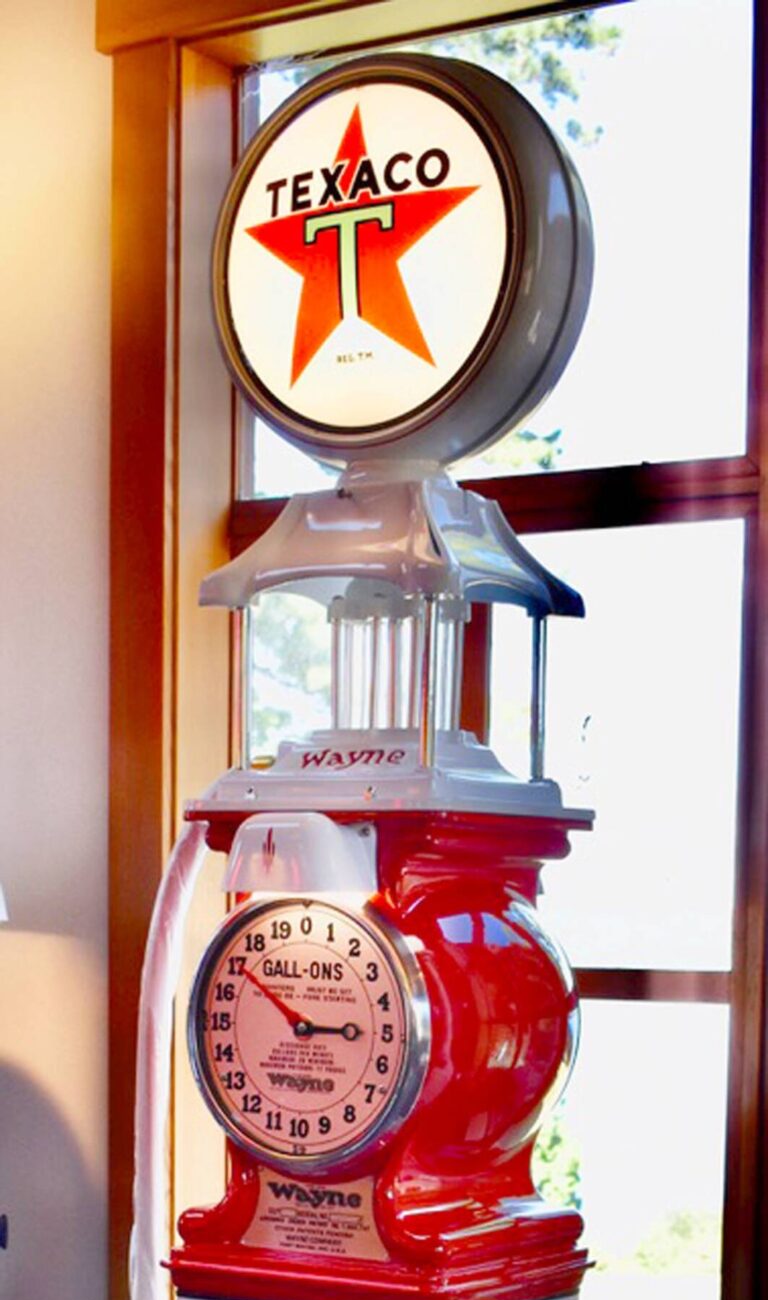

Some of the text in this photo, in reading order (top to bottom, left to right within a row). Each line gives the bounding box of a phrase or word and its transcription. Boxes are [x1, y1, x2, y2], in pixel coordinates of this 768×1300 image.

[266, 148, 450, 218] TEXACO
[303, 200, 394, 320] T
[301, 748, 406, 771] Wayne
[271, 921, 292, 939] 19
[301, 917, 312, 935] 0
[327, 923, 335, 942] 1
[245, 934, 266, 952] 18
[349, 938, 361, 957] 2
[228, 957, 247, 976] 17
[263, 959, 344, 982] GALL-ONS
[366, 963, 378, 982] 3
[216, 984, 235, 1001] 16
[377, 993, 390, 1011] 4
[211, 1012, 231, 1031] 15
[381, 1024, 393, 1043] 5
[215, 1043, 234, 1062] 14
[376, 1055, 389, 1074] 6
[226, 1071, 245, 1090] 13
[364, 1084, 376, 1103] 7
[241, 1094, 262, 1113] 12
[265, 1112, 283, 1130] 11
[343, 1105, 356, 1123] 8
[289, 1119, 309, 1138] 10
[318, 1116, 331, 1134] 9
[267, 1181, 362, 1208] Wayne
